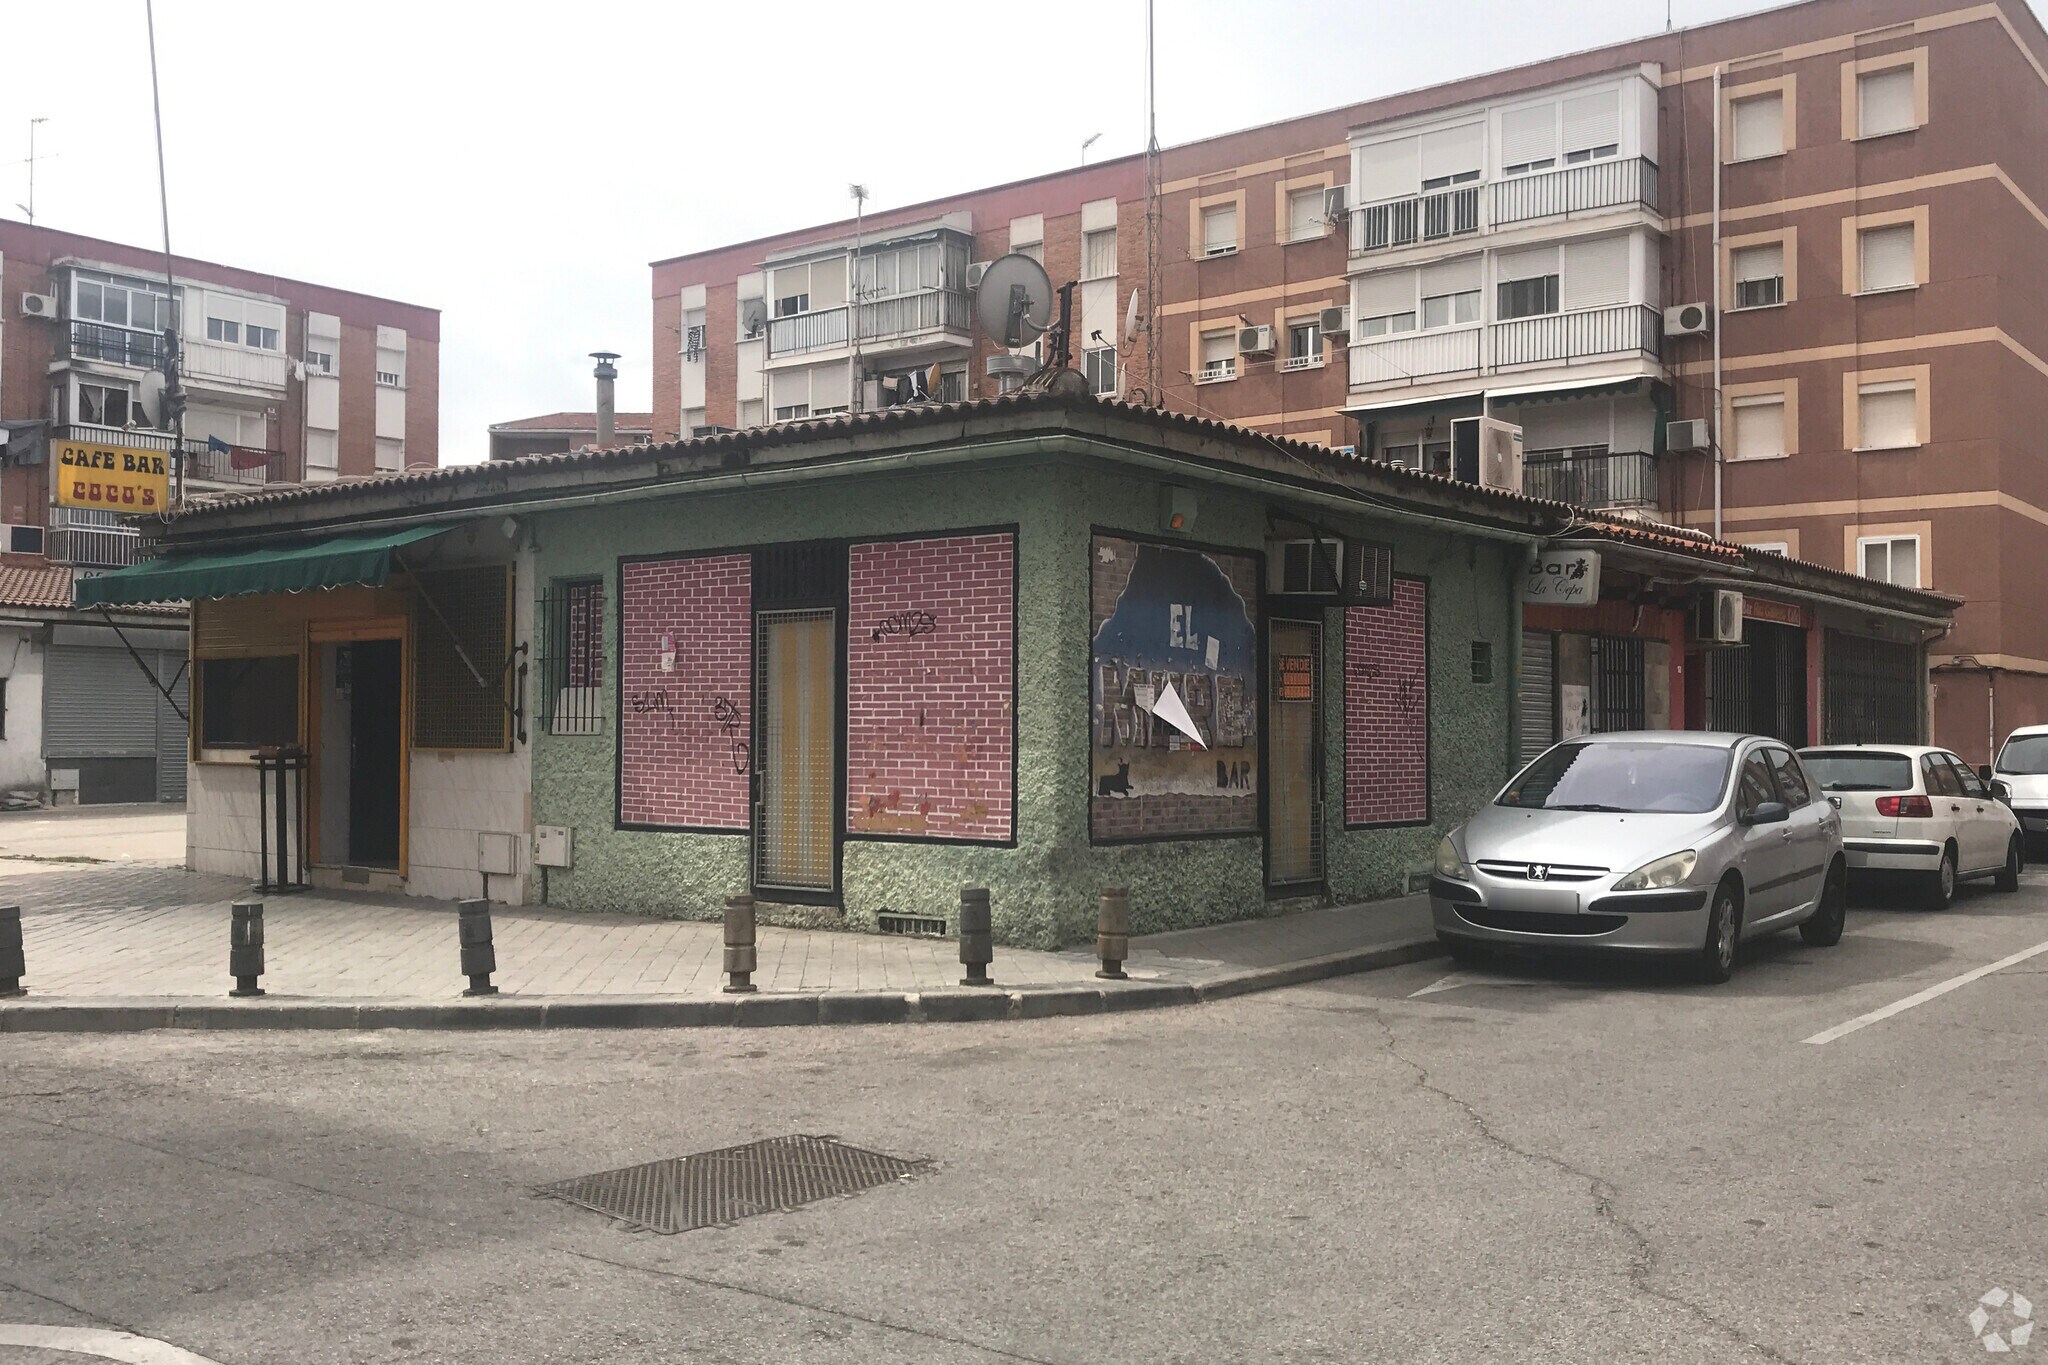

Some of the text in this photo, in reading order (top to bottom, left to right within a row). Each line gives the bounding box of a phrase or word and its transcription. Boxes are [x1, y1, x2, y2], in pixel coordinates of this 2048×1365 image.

[61, 447, 165, 475] CAFE BAR
[72, 481, 155, 506] COCO'S
[1528, 558, 1577, 575] Bar
[1527, 576, 1584, 601] La Cepa
[1169, 603, 1199, 651] EL
[1216, 760, 1250, 790] BAR
